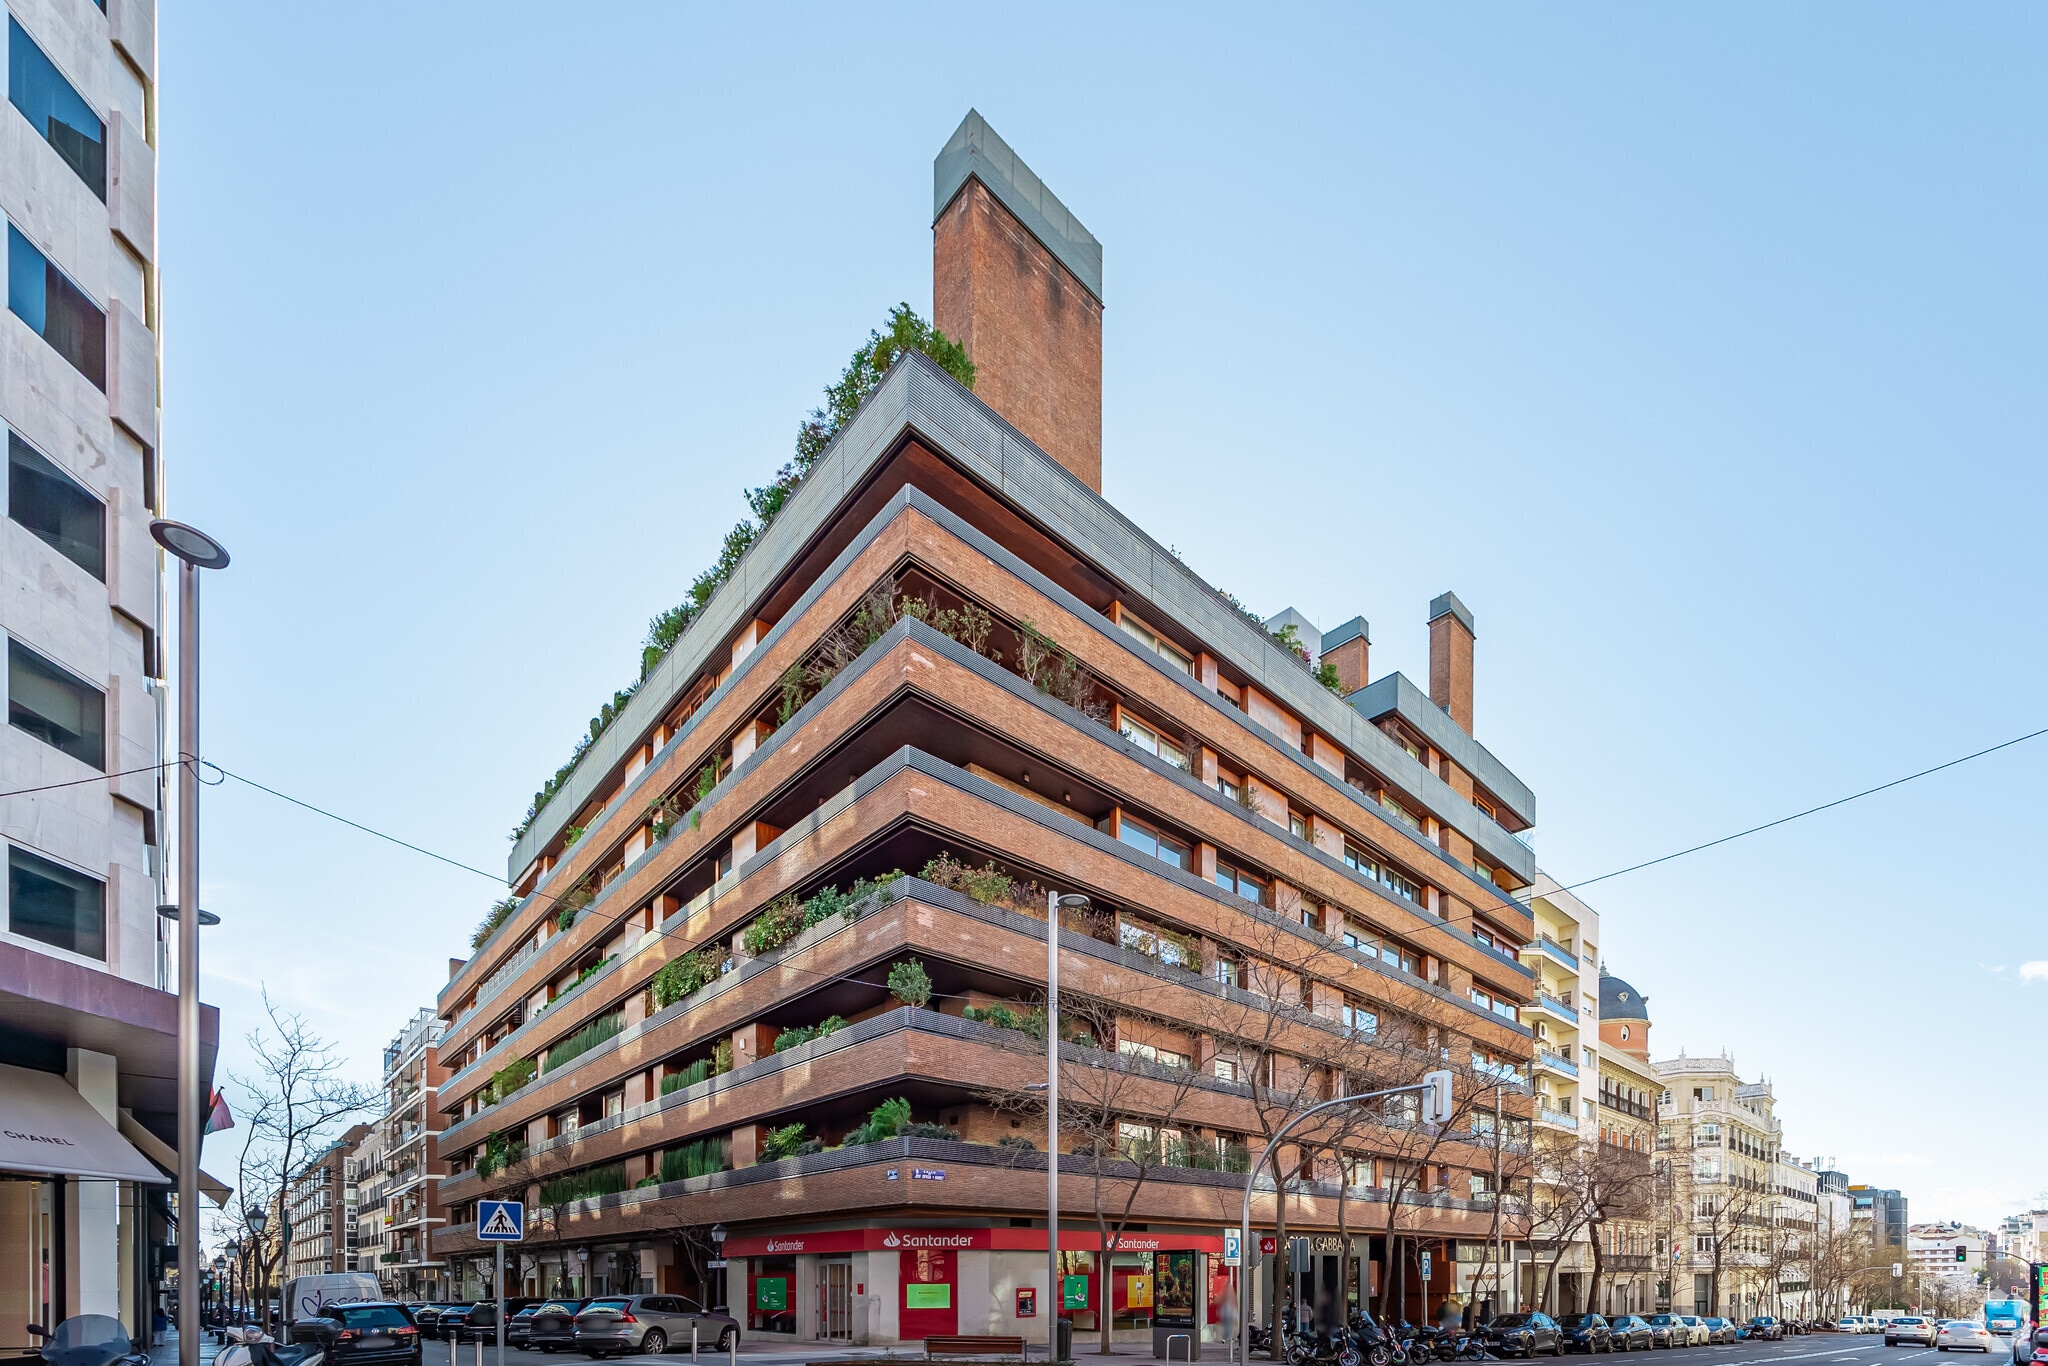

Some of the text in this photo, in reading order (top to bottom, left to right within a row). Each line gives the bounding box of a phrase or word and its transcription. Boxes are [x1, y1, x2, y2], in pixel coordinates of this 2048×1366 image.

[3, 1130, 75, 1146] CHANEL
[774, 1240, 804, 1251] Santander
[902, 1234, 974, 1247] Santander
[1118, 1238, 1160, 1249] Santander
[1315, 1237, 1356, 1251] GABBAA
[1227, 1239, 1236, 1257] P
